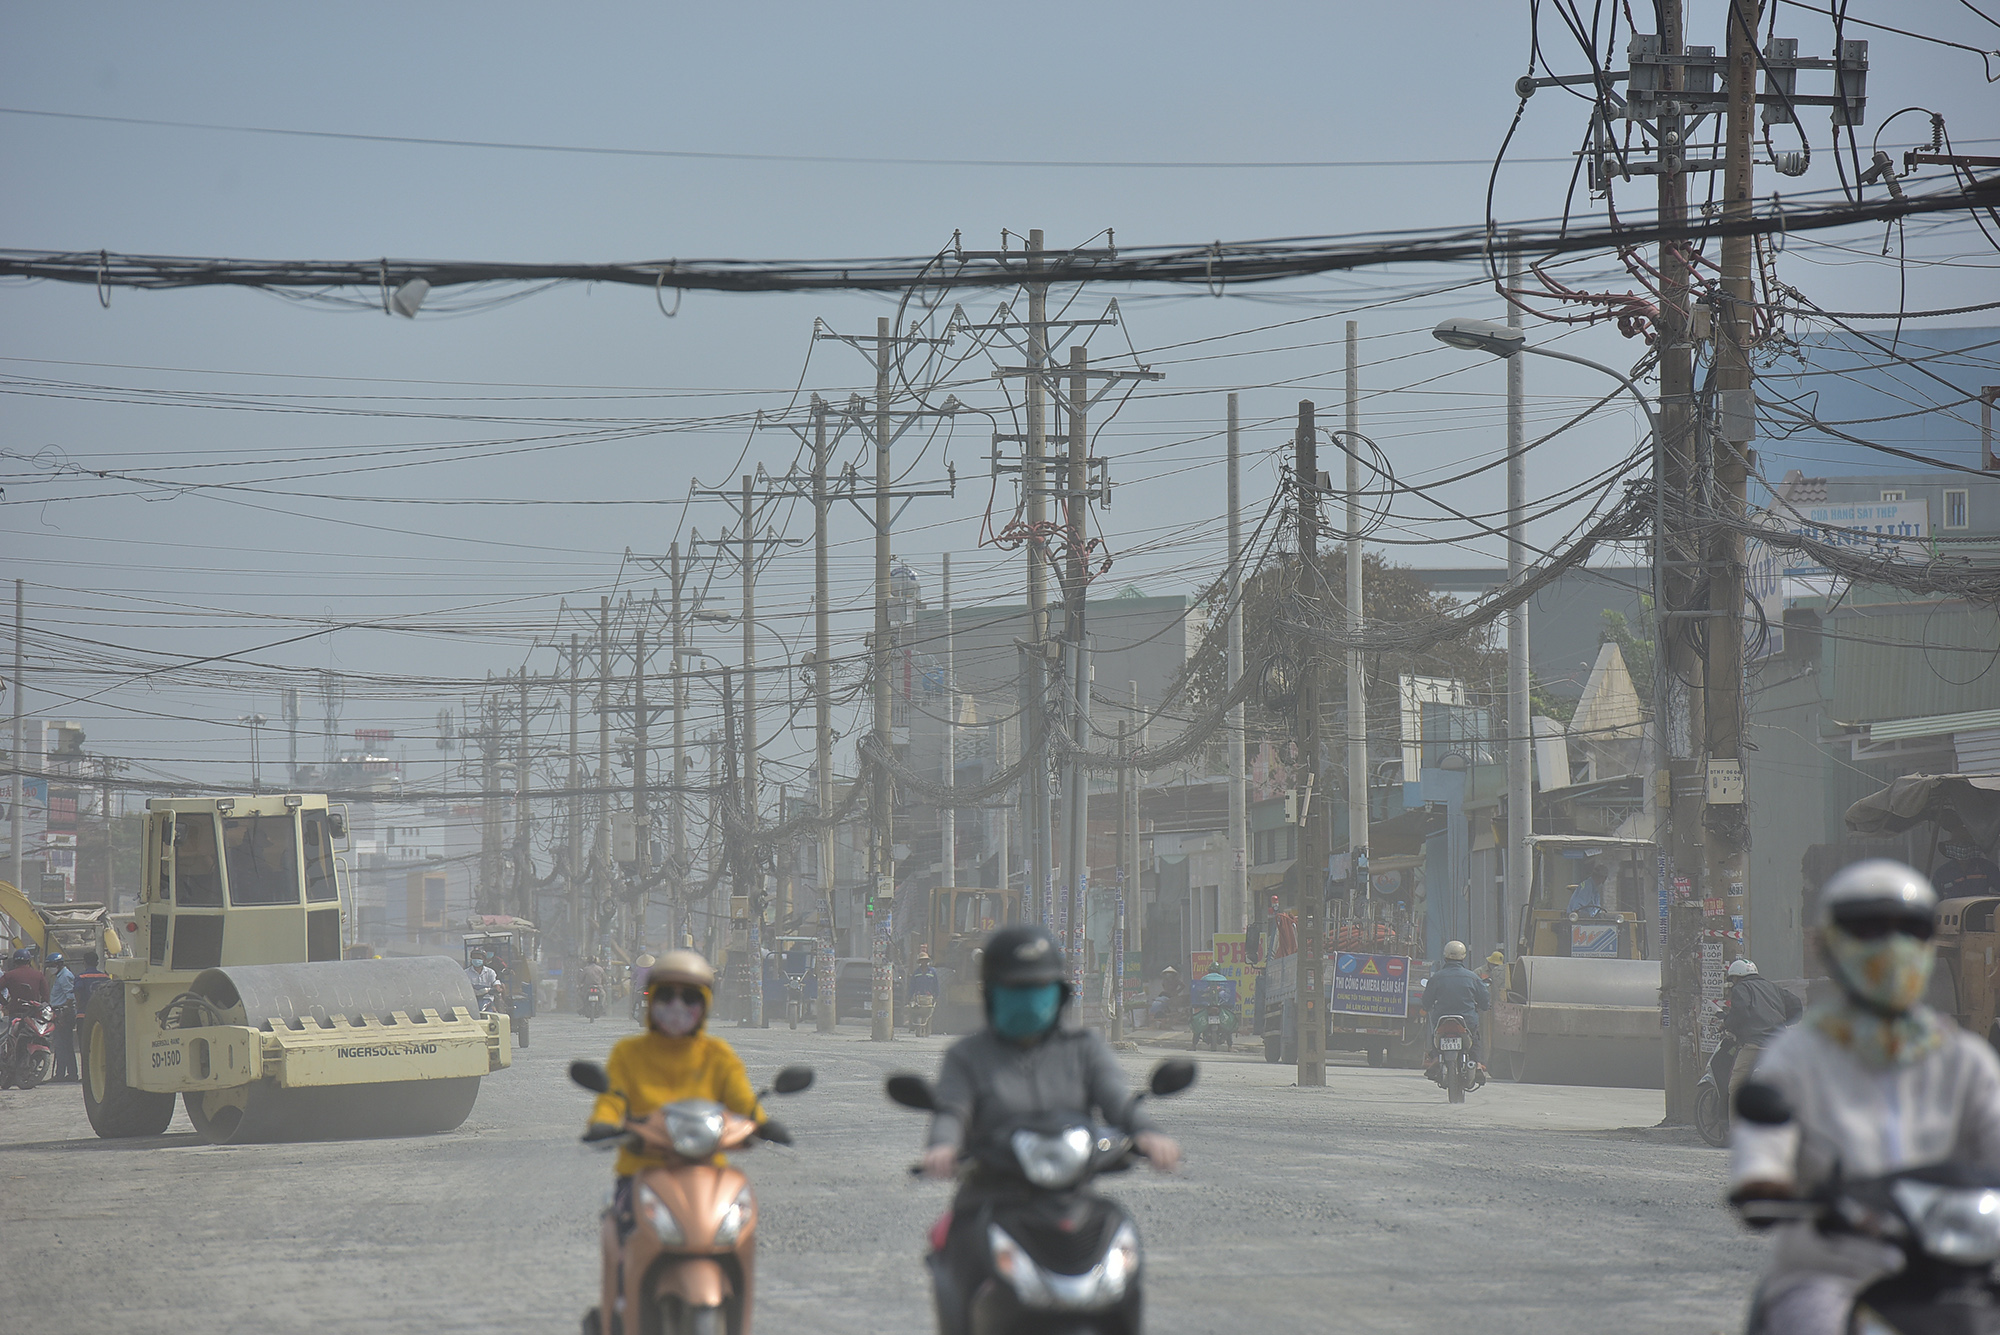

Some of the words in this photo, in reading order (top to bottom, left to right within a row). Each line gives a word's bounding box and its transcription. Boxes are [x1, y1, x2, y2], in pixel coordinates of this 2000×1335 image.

[1336, 976, 1344, 989] THI
[1345, 975, 1359, 990] CÔNG
[1360, 978, 1380, 992] CAMERA
[1381, 977, 1393, 992] GIÁM
[1394, 977, 1404, 993] SÁT
[152, 1049, 181, 1068] SD-150D
[337, 1044, 401, 1058] INGERSOLL
